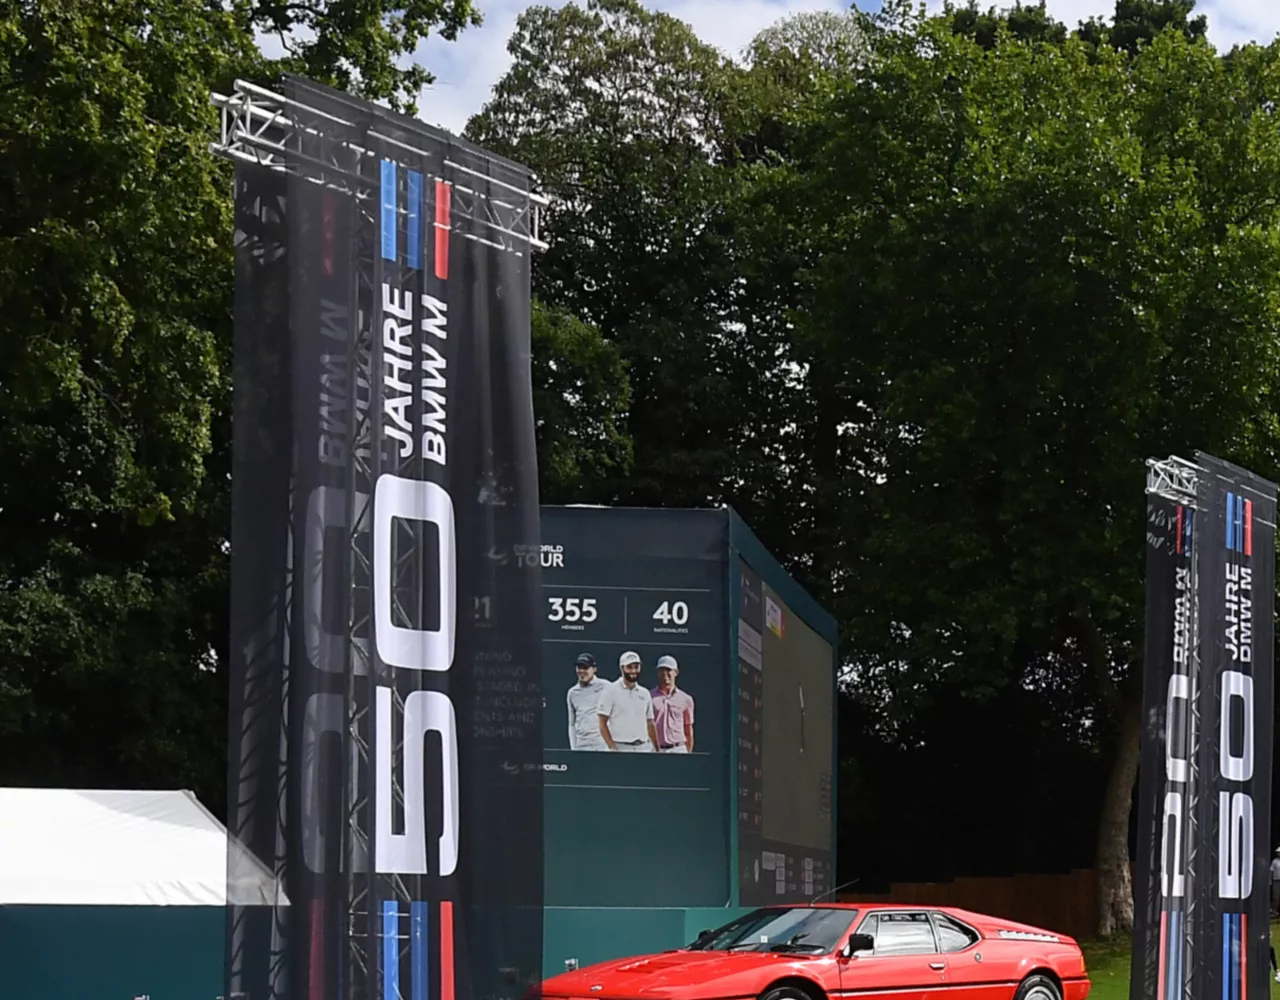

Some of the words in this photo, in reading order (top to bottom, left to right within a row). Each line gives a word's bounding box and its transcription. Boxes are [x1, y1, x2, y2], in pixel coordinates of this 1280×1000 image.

[421, 294, 448, 339] M
[381, 282, 414, 458] JAHRE
[421, 344, 447, 466] BMW
[515, 553, 564, 567] TOUR
[1240, 566, 1252, 590] M
[548, 597, 597, 622] 355
[652, 601, 688, 625] 40
[1225, 562, 1239, 660] JAHRE
[374, 473, 460, 876] 50
[1219, 670, 1254, 900] 50
